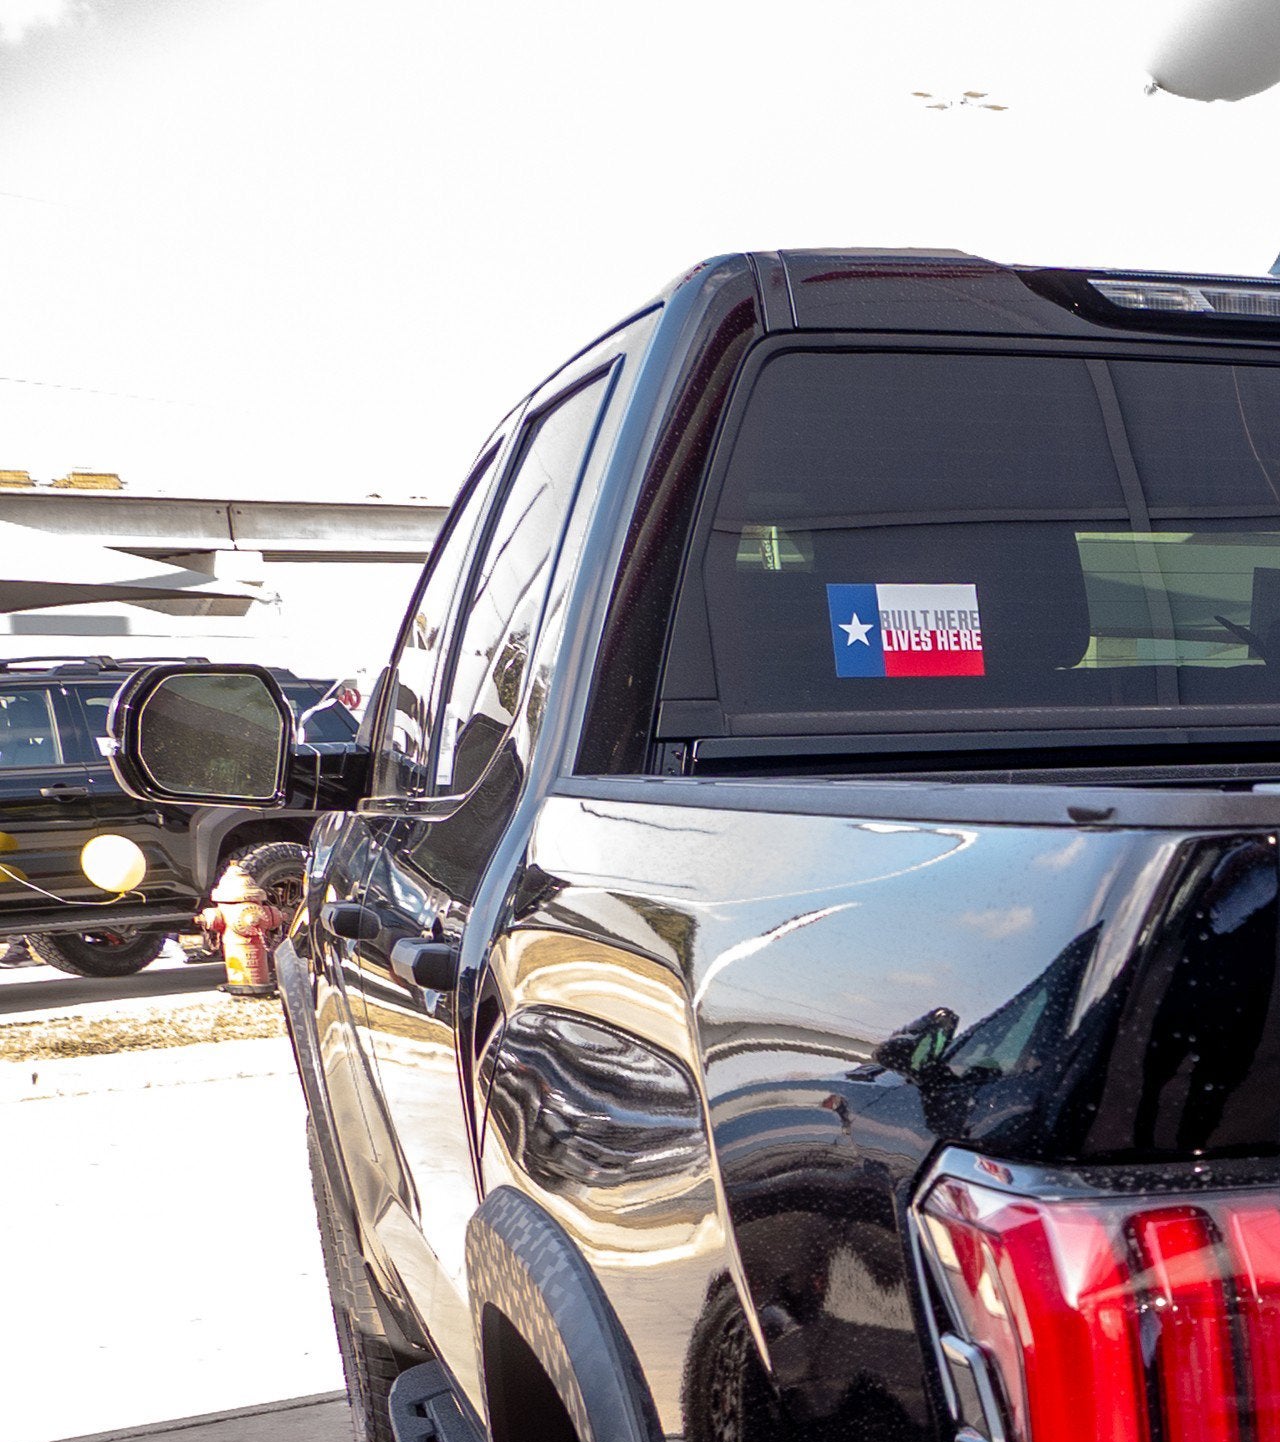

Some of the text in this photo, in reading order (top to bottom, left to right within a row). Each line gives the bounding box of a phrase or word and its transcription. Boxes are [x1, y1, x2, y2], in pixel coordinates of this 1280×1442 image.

[879, 610, 981, 631] BUILT HERE
[881, 630, 983, 652] LIVES HERE
